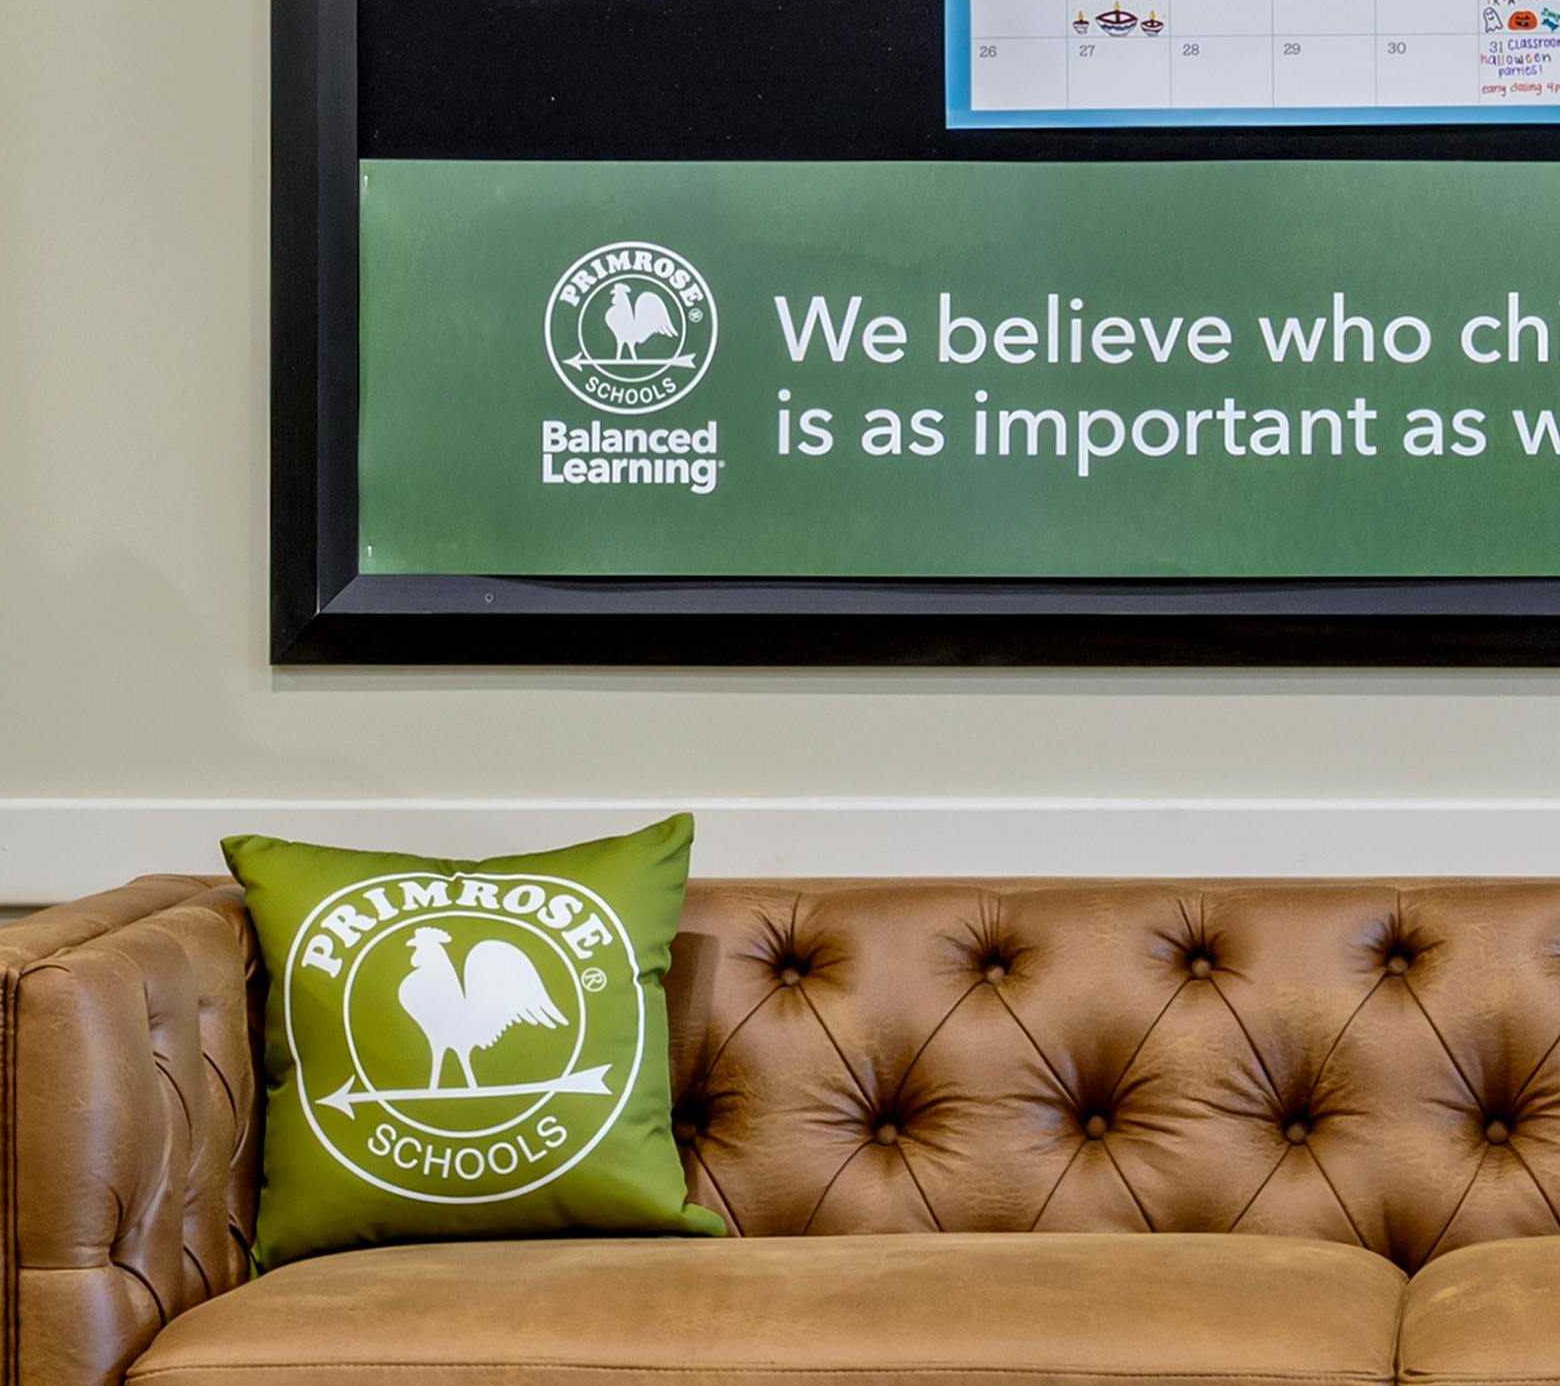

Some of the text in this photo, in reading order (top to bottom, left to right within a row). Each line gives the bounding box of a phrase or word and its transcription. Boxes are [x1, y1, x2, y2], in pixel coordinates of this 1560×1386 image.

[979, 45, 997, 58] 26
[1079, 44, 1096, 57] 27
[1182, 43, 1200, 56] 28
[1283, 43, 1301, 55] 29
[1388, 42, 1406, 54] 30
[1489, 41, 1503, 53] 31
[774, 295, 908, 363] We
[938, 293, 1233, 364] believe
[1258, 292, 1432, 363] who
[584, 375, 678, 407] SCHOOLS
[542, 420, 718, 454] Balanced
[777, 389, 834, 456] is
[861, 408, 945, 457] as
[973, 390, 1376, 476] important
[1402, 407, 1487, 456] as
[367, 1115, 569, 1180] SCHOOLS
